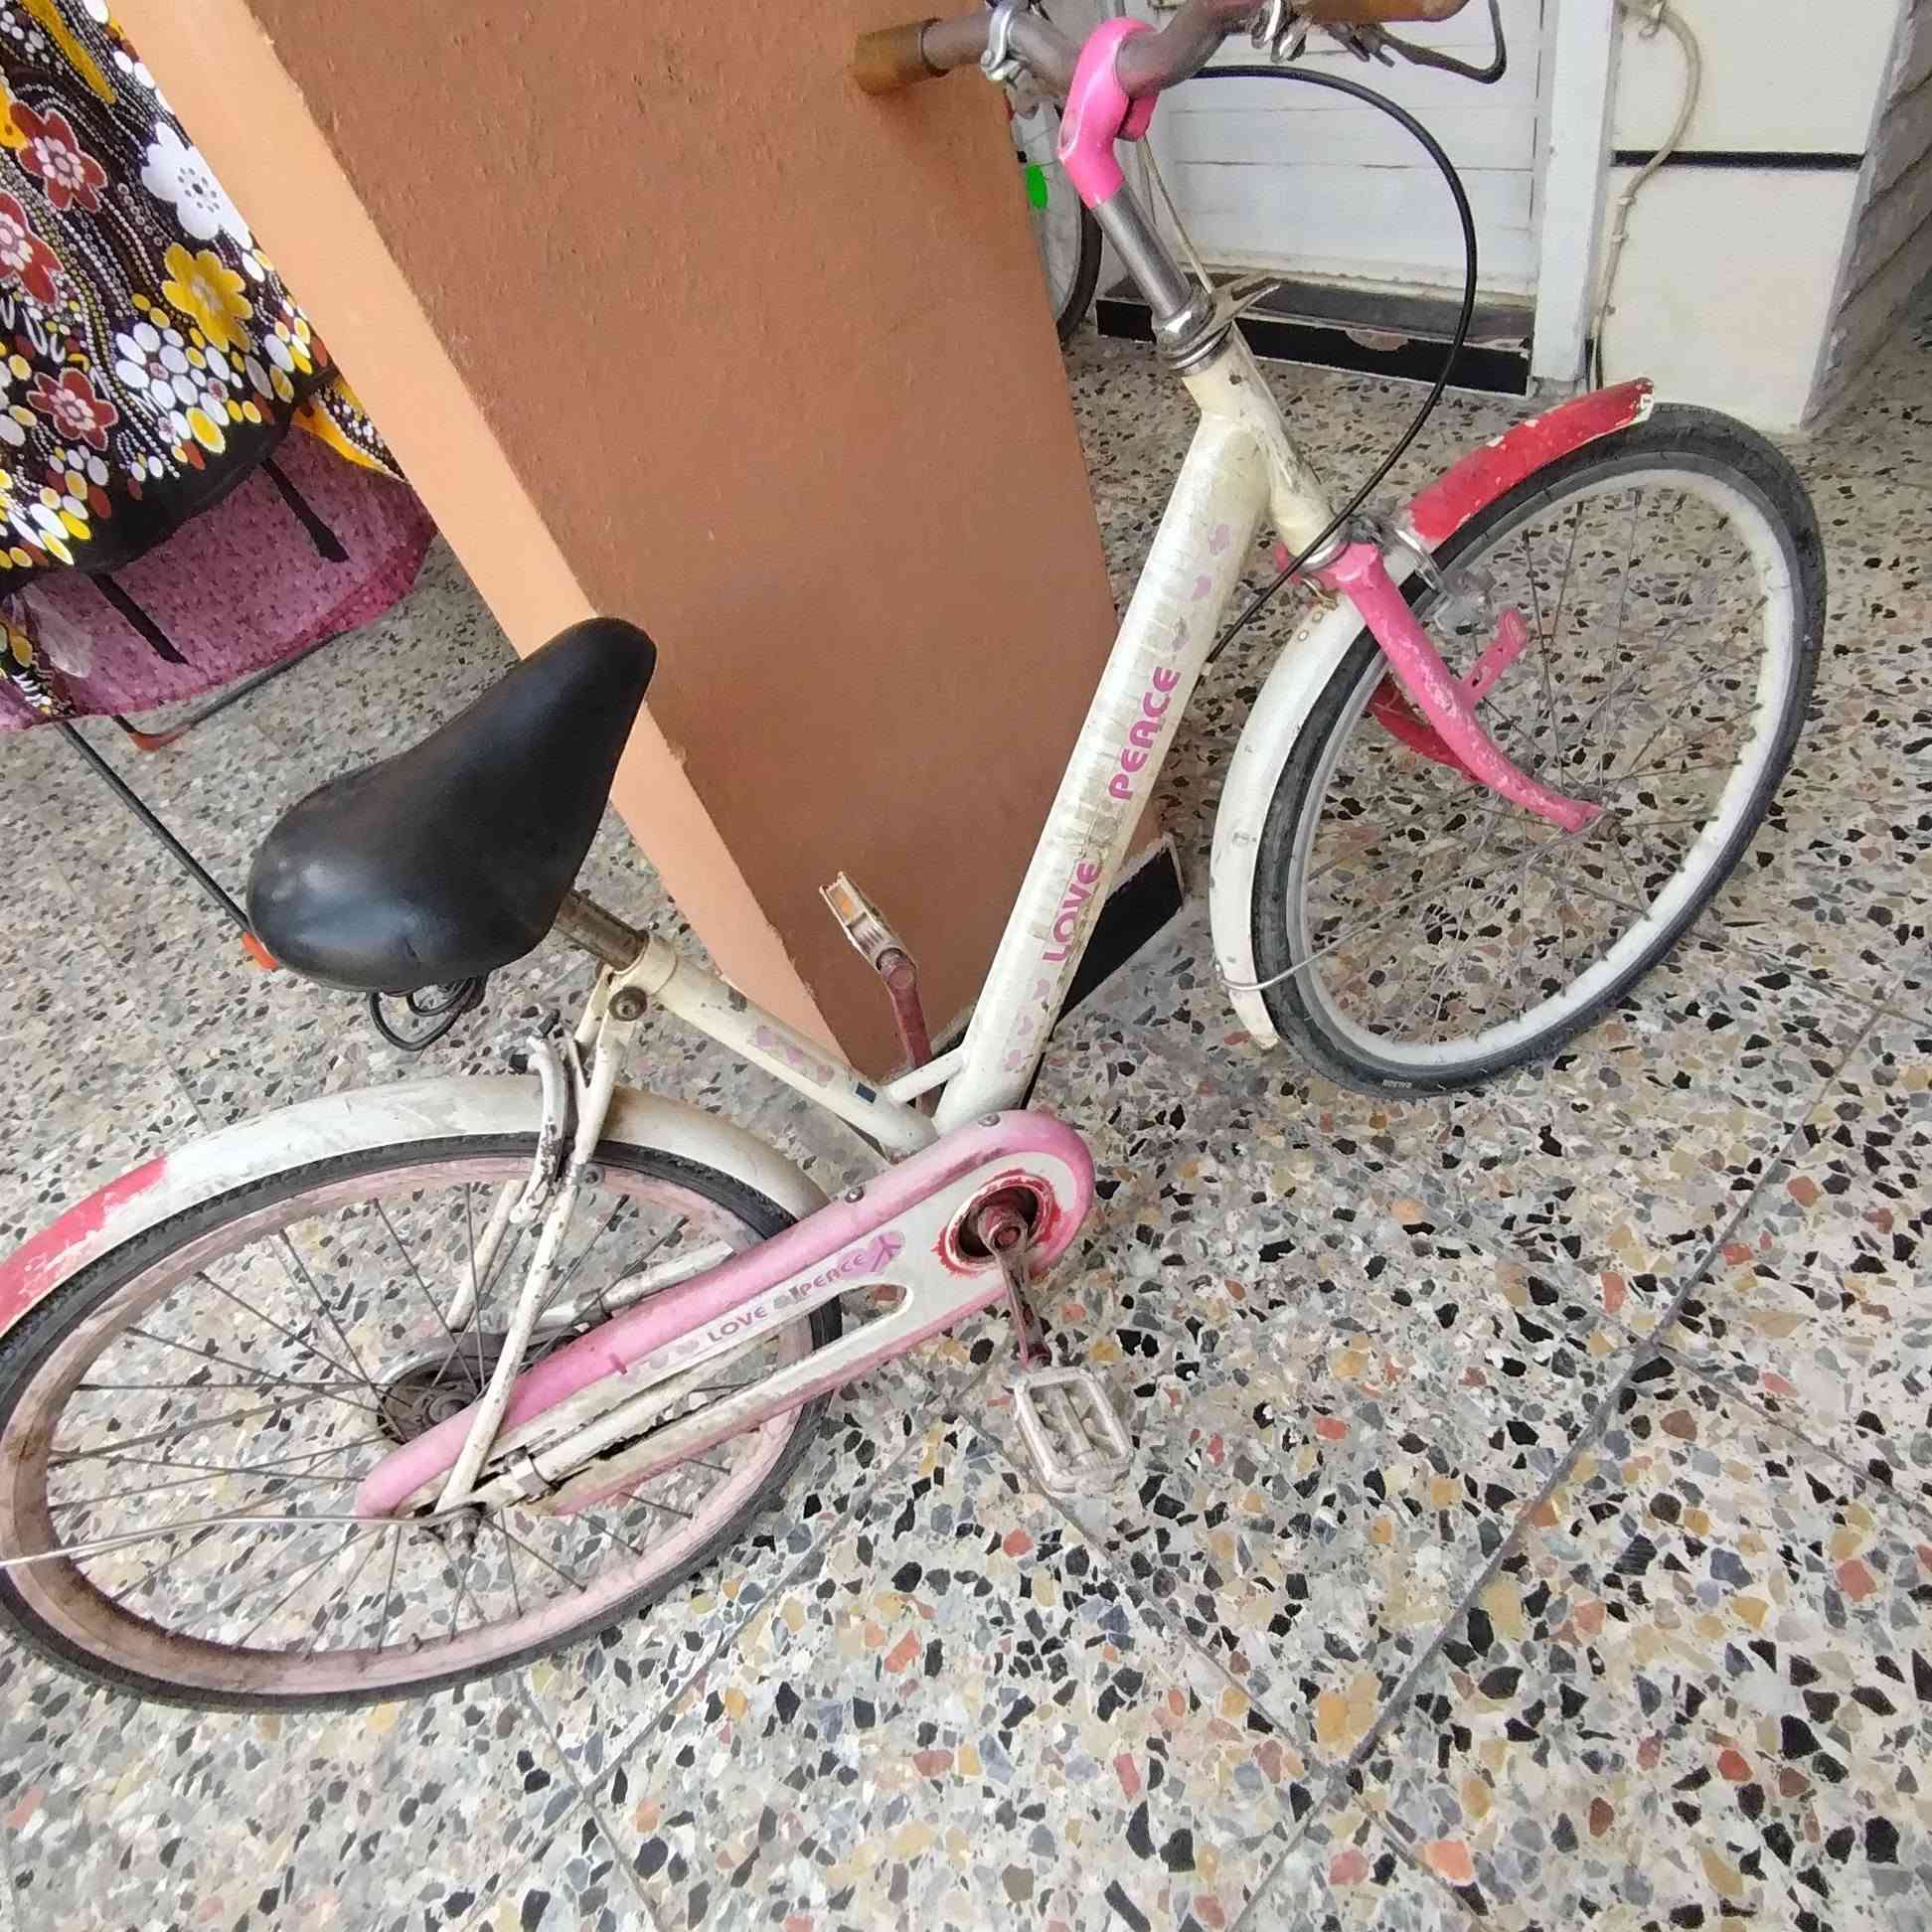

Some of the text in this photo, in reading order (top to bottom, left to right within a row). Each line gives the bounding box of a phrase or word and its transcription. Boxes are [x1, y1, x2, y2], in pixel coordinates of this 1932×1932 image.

[1043, 666, 1181, 962] LOVE PEACE
[707, 1254, 866, 1343] LOVE PEACE
